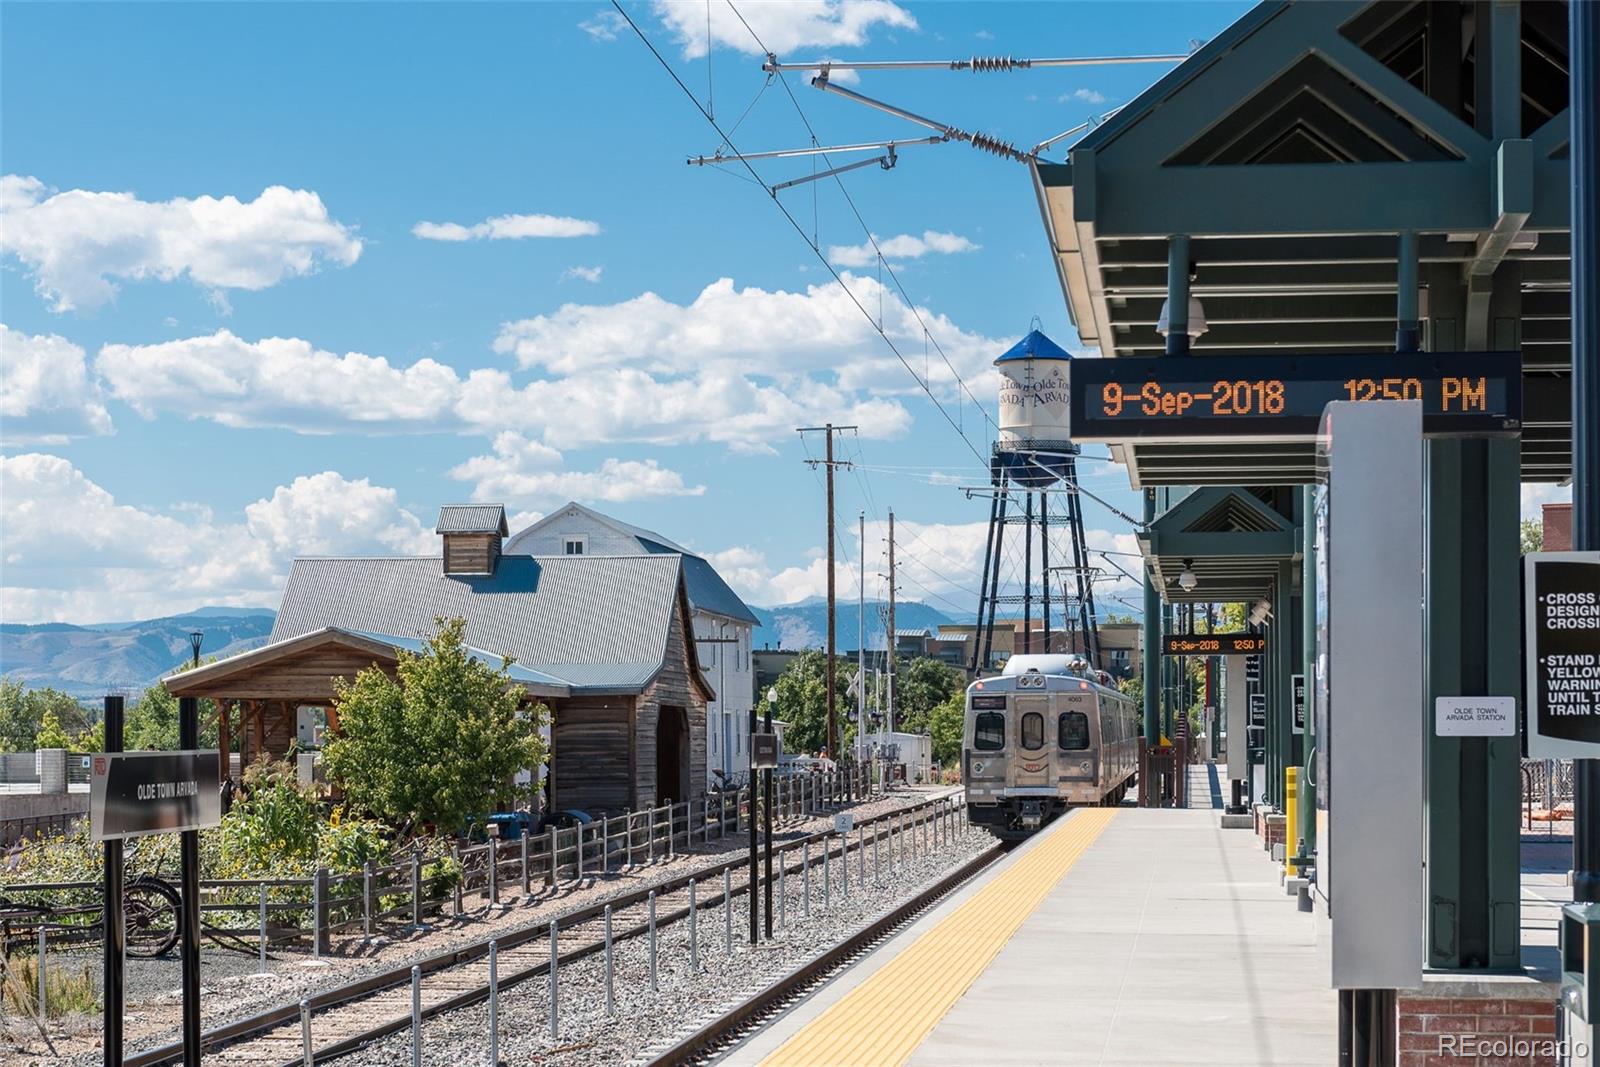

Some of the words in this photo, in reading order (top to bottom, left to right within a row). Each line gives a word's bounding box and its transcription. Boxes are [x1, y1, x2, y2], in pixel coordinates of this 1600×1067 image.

[1033, 379, 1056, 392] Olde
[1033, 391, 1070, 408] ARVAD
[1103, 380, 1285, 416] 9-Sep-2018
[1344, 378, 1423, 401] 12:50
[1442, 377, 1486, 412] PM
[1546, 593, 1596, 604] CROSS
[1547, 605, 1600, 617] DESIGN
[1547, 618, 1600, 629] CROSSI
[1258, 639, 1265, 649] P
[1547, 655, 1595, 666] STAND
[1548, 667, 1600, 678] YELLOW
[1548, 692, 1590, 703] UNTIL
[1454, 707, 1473, 715] OLDE
[1548, 704, 1590, 716] TRAIN
[137, 783, 156, 800] OLDE
[157, 781, 176, 799] TOWN
[176, 780, 198, 797] ARVADA
